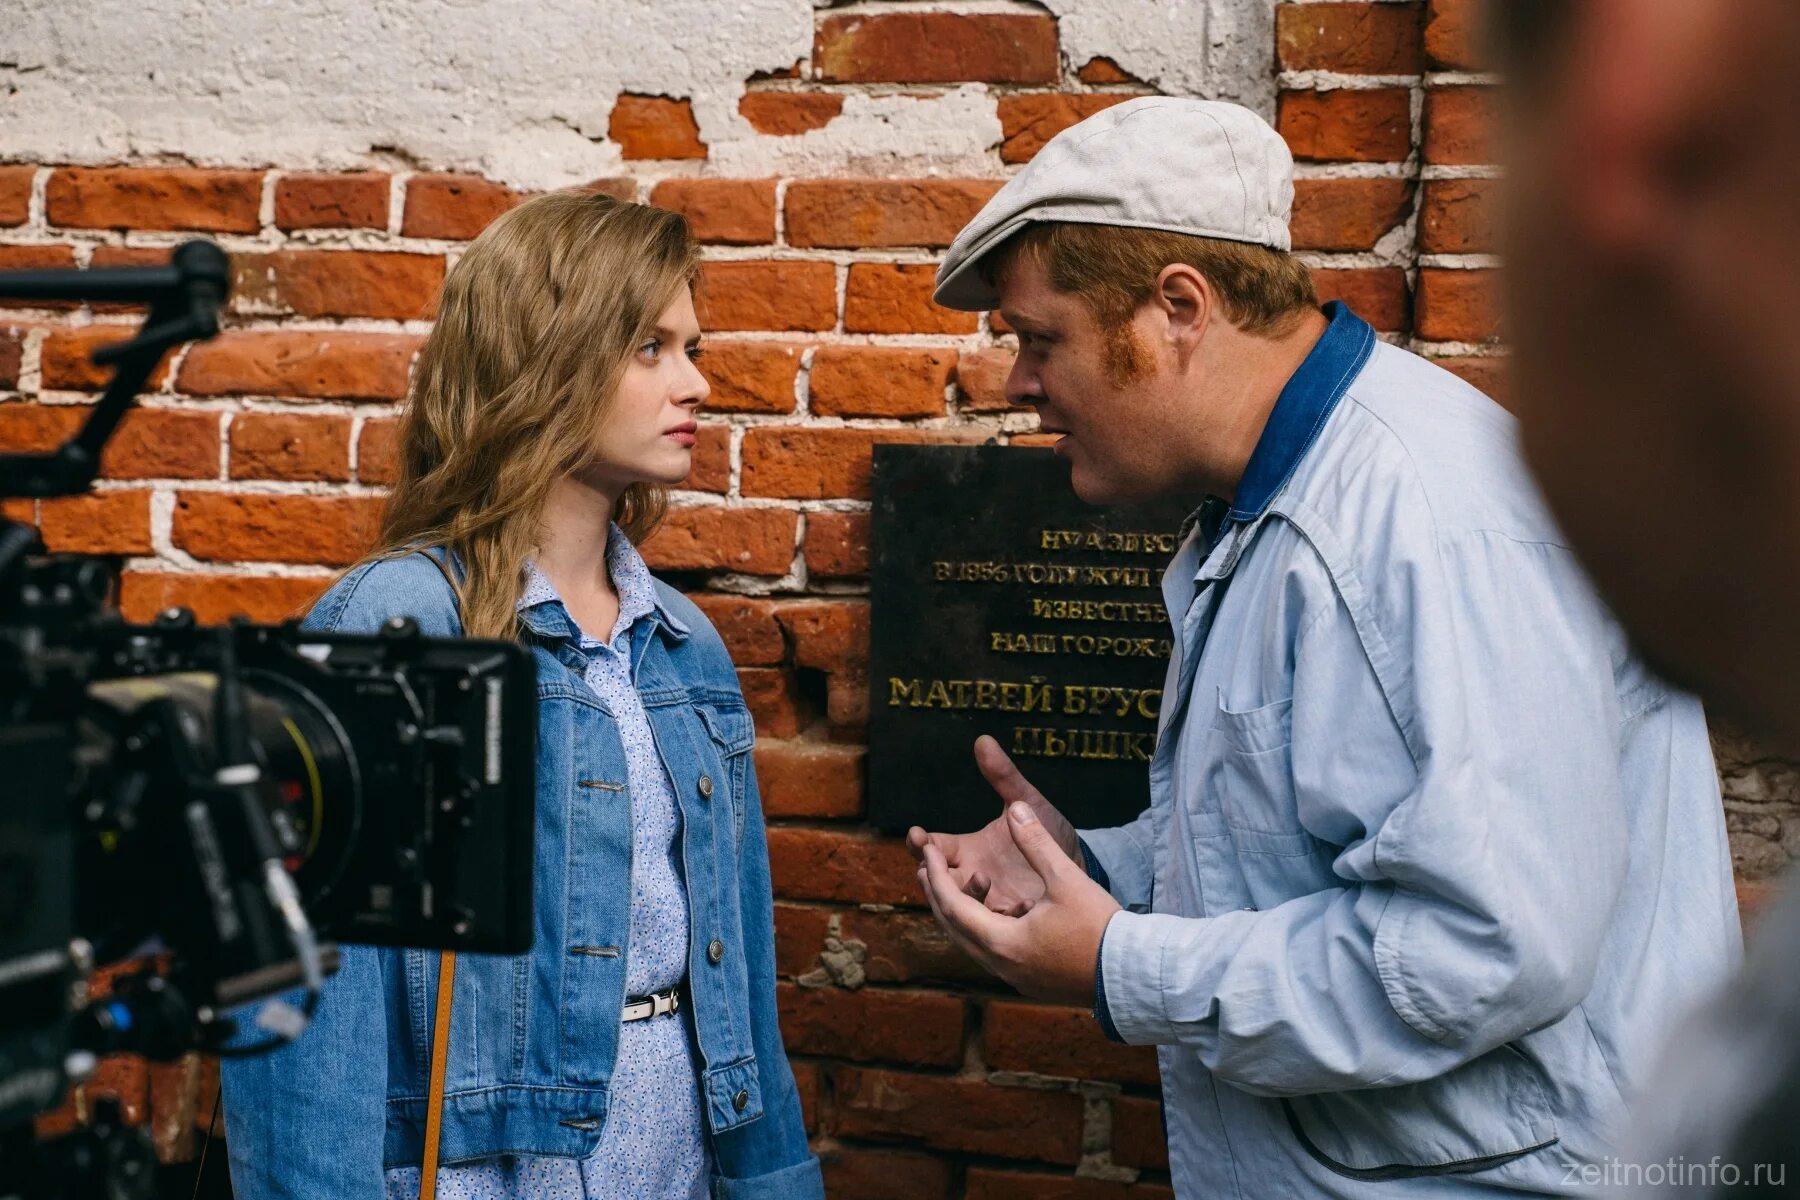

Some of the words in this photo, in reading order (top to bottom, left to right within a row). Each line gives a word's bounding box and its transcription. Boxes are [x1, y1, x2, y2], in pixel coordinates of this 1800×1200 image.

[953, 562, 1009, 583] 1856
[1014, 563, 1082, 585] ГОДУ
[1083, 566, 1151, 588] ЖИЛ
[991, 632, 1057, 653] НАШ
[887, 675, 1053, 714] МАТВЕЙ
[1062, 685, 1163, 719] БРУС
[1012, 726, 1158, 761] ПЫШК
